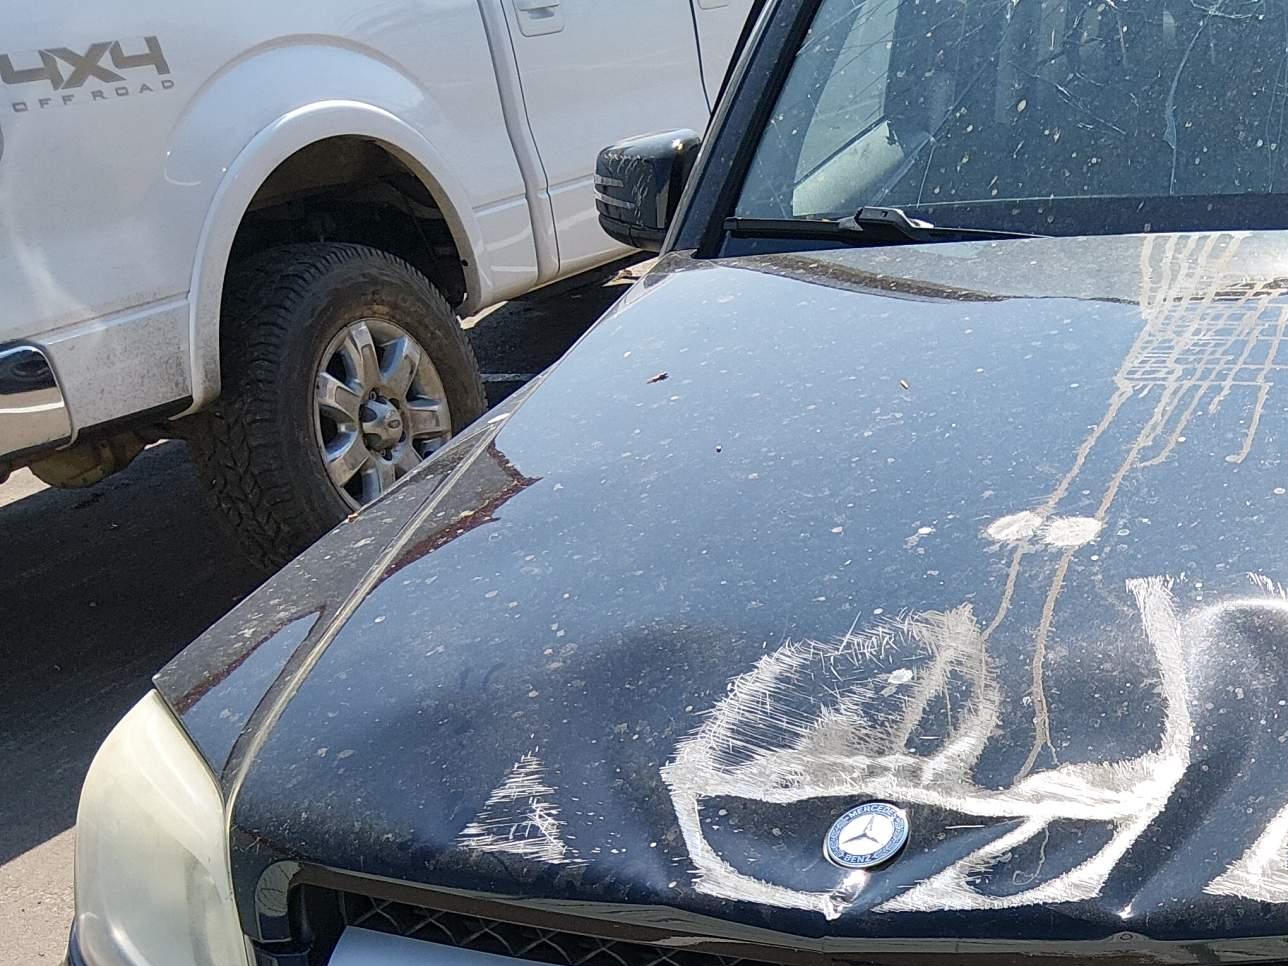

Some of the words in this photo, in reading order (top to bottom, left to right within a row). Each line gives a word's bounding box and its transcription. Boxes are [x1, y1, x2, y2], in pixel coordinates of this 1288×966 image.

[12, 94, 76, 113] OFF
[91, 79, 175, 101] ROAD
[843, 854, 872, 863] BENZ
